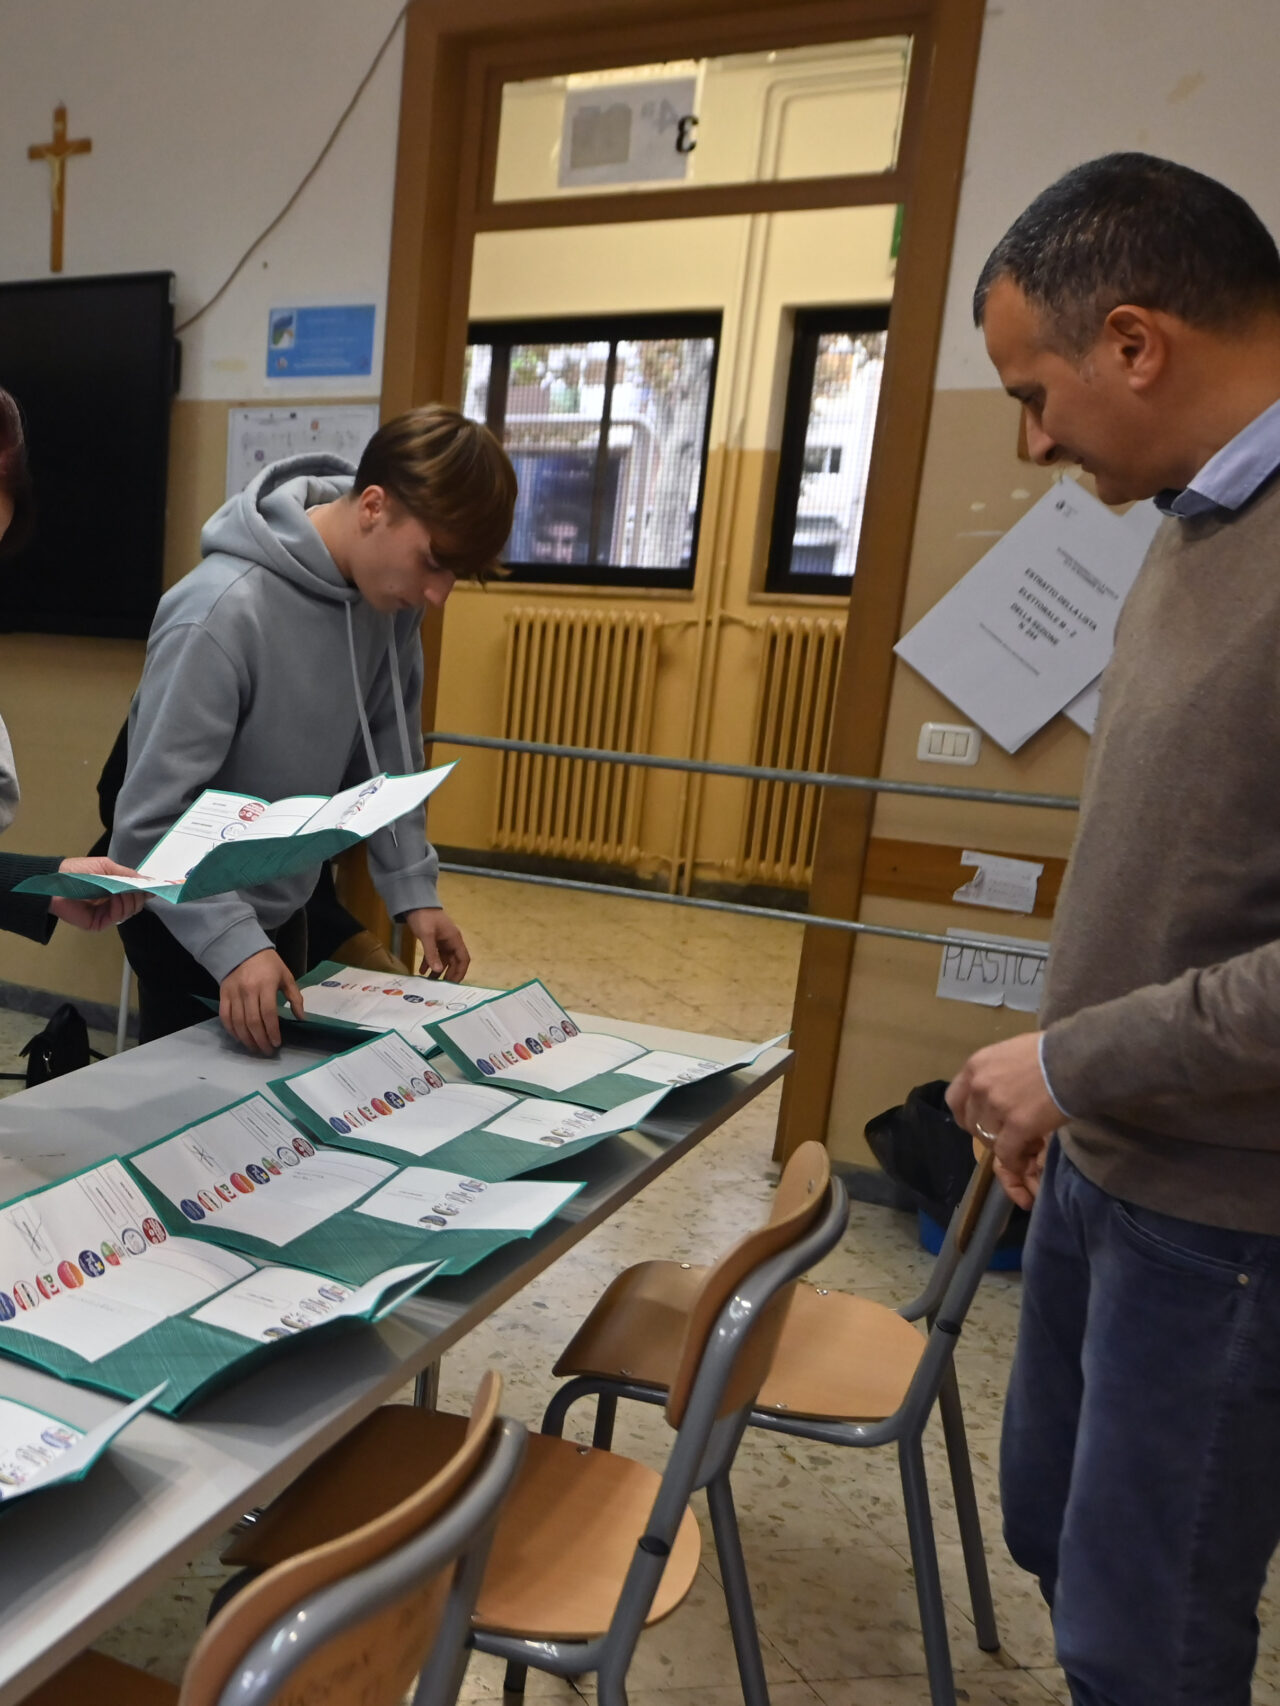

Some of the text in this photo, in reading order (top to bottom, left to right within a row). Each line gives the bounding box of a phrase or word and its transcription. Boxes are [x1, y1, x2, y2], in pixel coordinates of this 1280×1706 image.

[1018, 586, 1060, 624] ELETTORALE
[1024, 567, 1097, 632] ESTRATTO DELLA LISTA
[1010, 602, 1059, 645] DELLA SEZIONE
